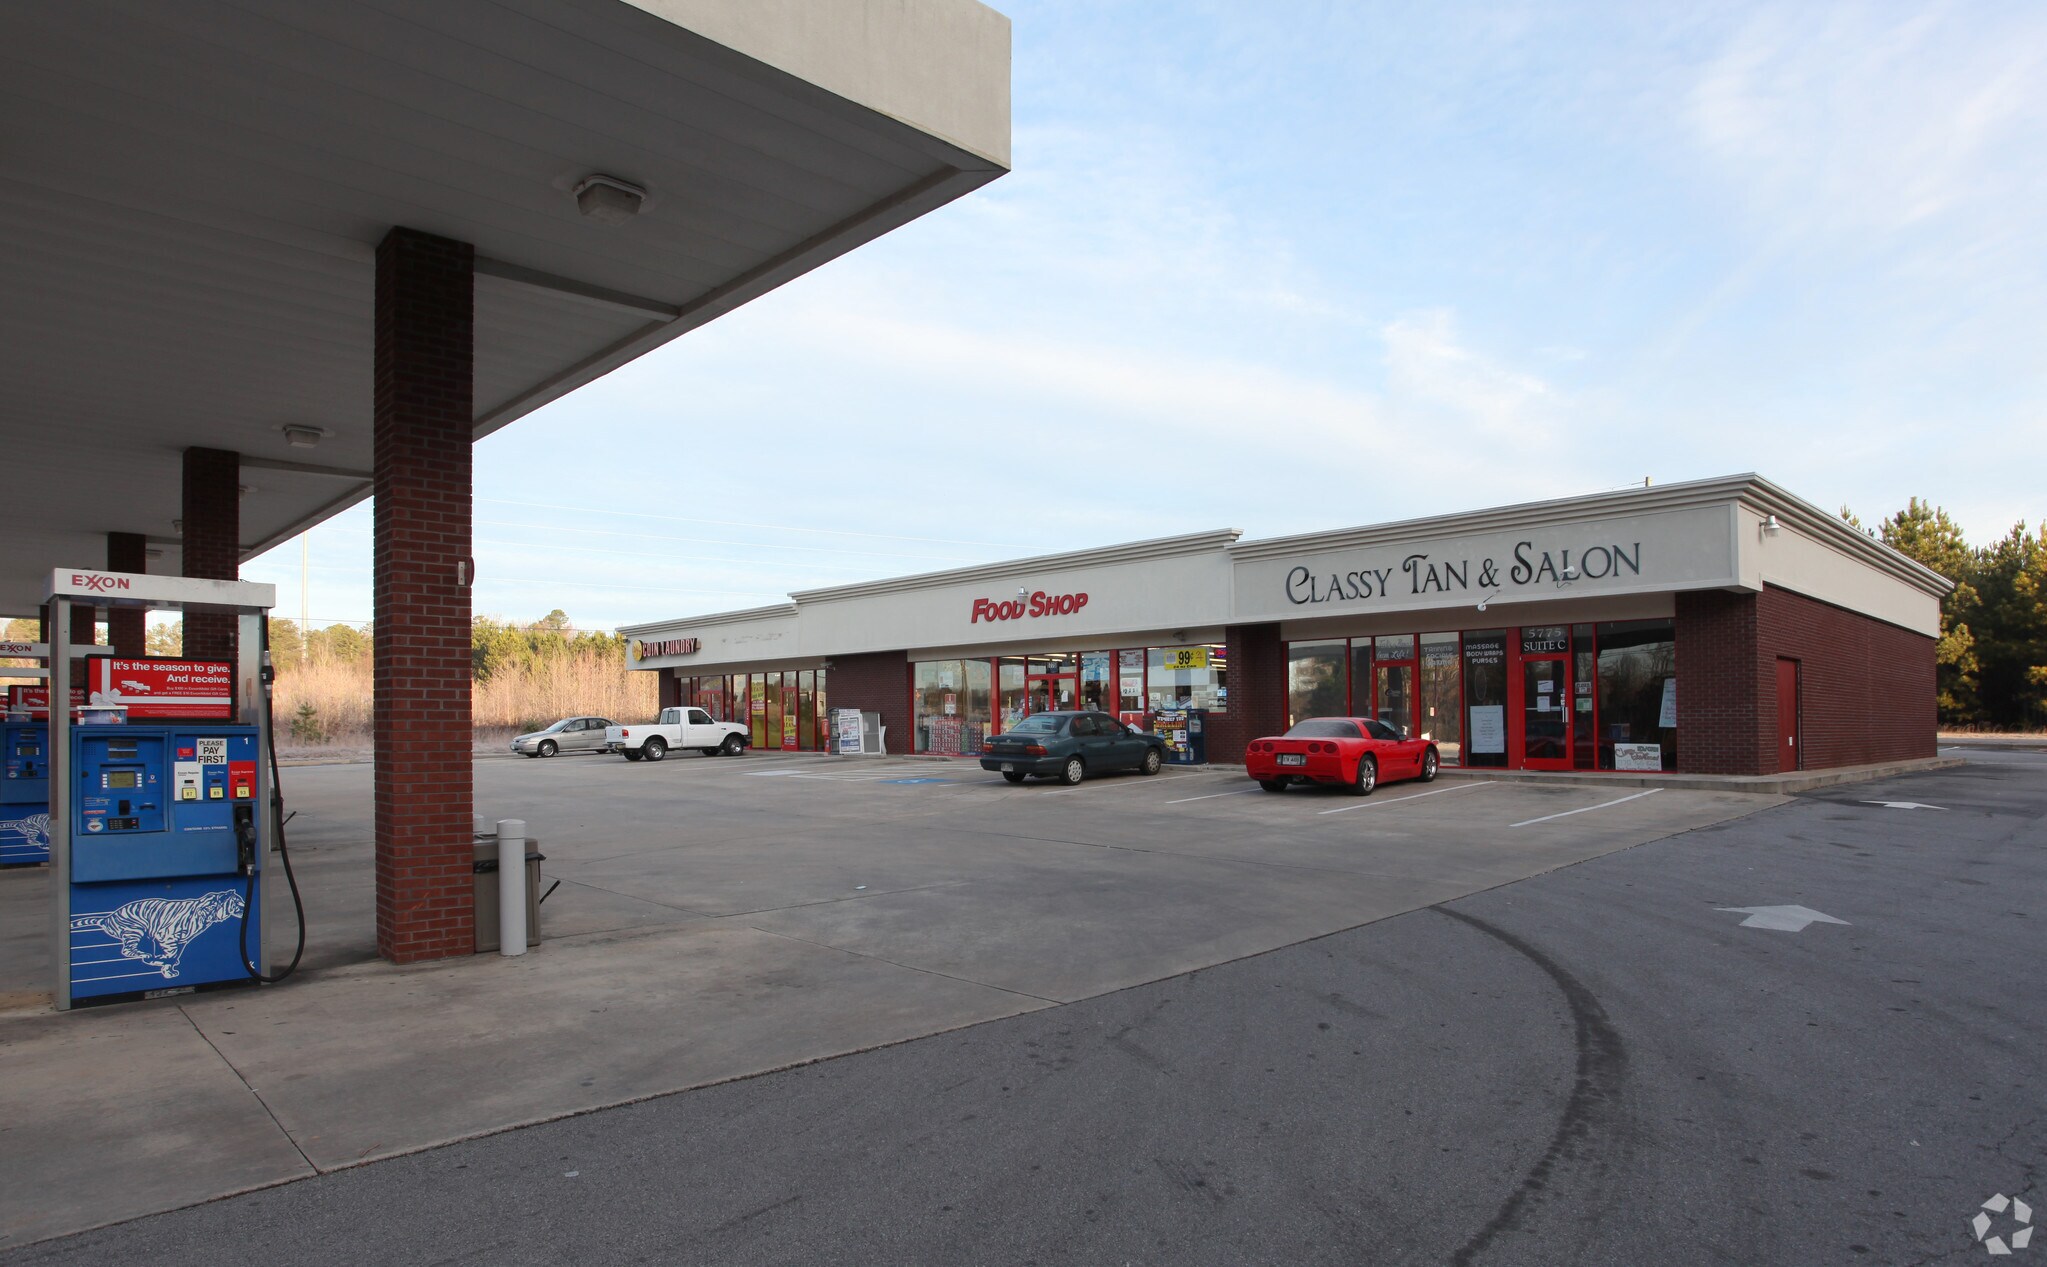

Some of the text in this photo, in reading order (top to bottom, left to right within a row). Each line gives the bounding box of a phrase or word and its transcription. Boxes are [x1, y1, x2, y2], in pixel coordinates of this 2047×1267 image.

[1285, 541, 1640, 605] CLASSY TAN & SALON
[71, 574, 130, 592] EXXON
[1028, 591, 1089, 618] SHOP
[1528, 628, 1562, 638] 5775
[0, 644, 32, 653] EXXON
[642, 637, 696, 657] COIN LAUNDRY
[1523, 640, 1566, 651] SUITE C
[113, 661, 230, 674] It's the season to give.
[167, 674, 230, 684] And receive.
[244, 737, 249, 745] 1
[198, 755, 225, 763] FIRST
